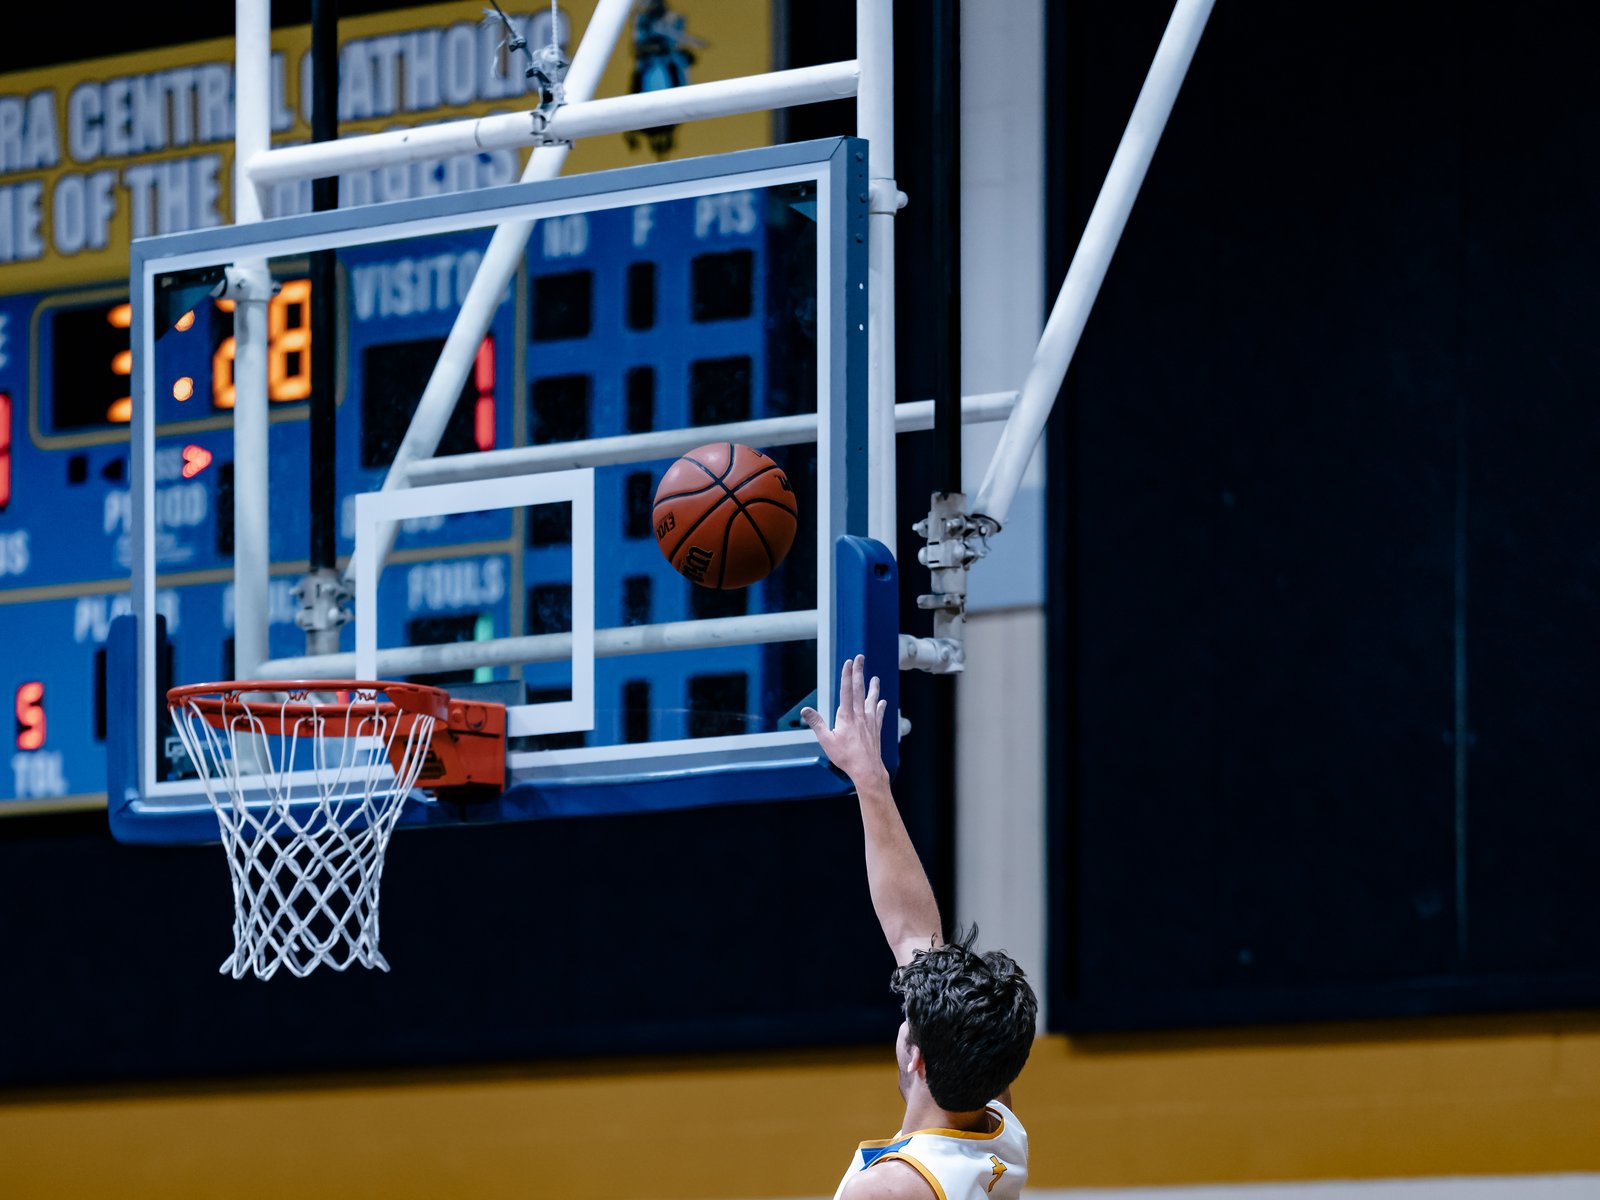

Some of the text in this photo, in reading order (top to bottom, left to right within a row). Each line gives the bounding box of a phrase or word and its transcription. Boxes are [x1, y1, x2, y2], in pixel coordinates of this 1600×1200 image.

[68, 53, 293, 165] CENTRL
[302, 9, 571, 127] ATHOLIC
[53, 169, 118, 256] OF
[122, 154, 223, 238] THE
[632, 205, 653, 248] F
[695, 192, 758, 239] PTS
[352, 250, 511, 322] VISITO
[16, 681, 47, 750] 5
